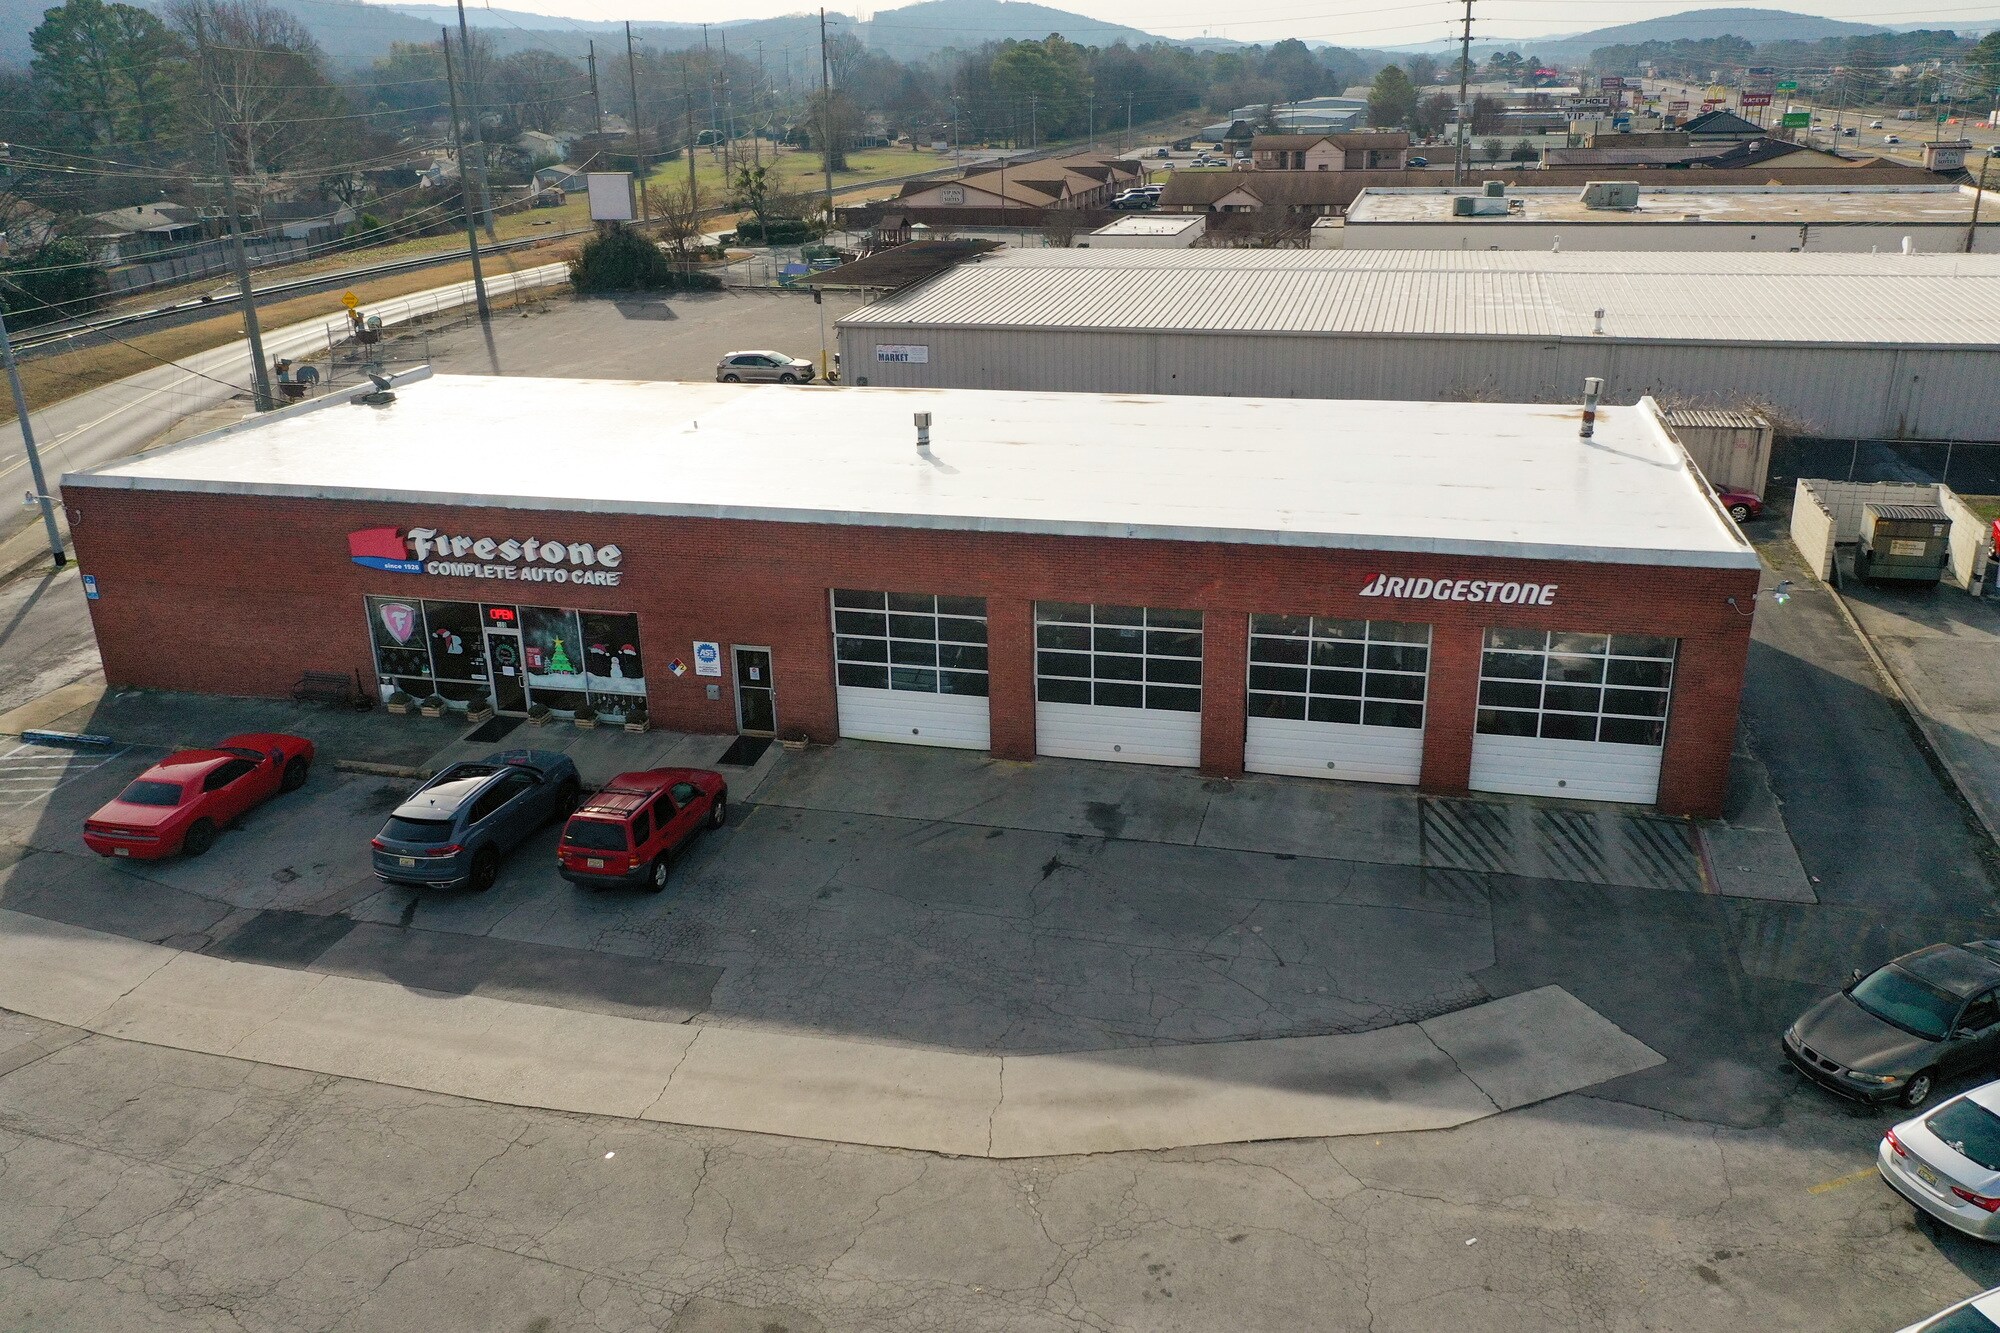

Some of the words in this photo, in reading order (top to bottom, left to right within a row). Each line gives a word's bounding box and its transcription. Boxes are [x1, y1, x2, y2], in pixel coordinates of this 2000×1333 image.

[1566, 112, 1585, 120] VIP
[878, 353, 909, 362] MARKET
[407, 527, 622, 568] Firestone
[384, 562, 402, 570] since
[403, 563, 420, 571] 1926
[427, 560, 517, 580] COMPLETE
[520, 566, 569, 583] AUTO
[571, 569, 621, 586] CARE
[1358, 573, 1559, 606] BRIDGESTONE
[489, 608, 515, 621] OPEN
